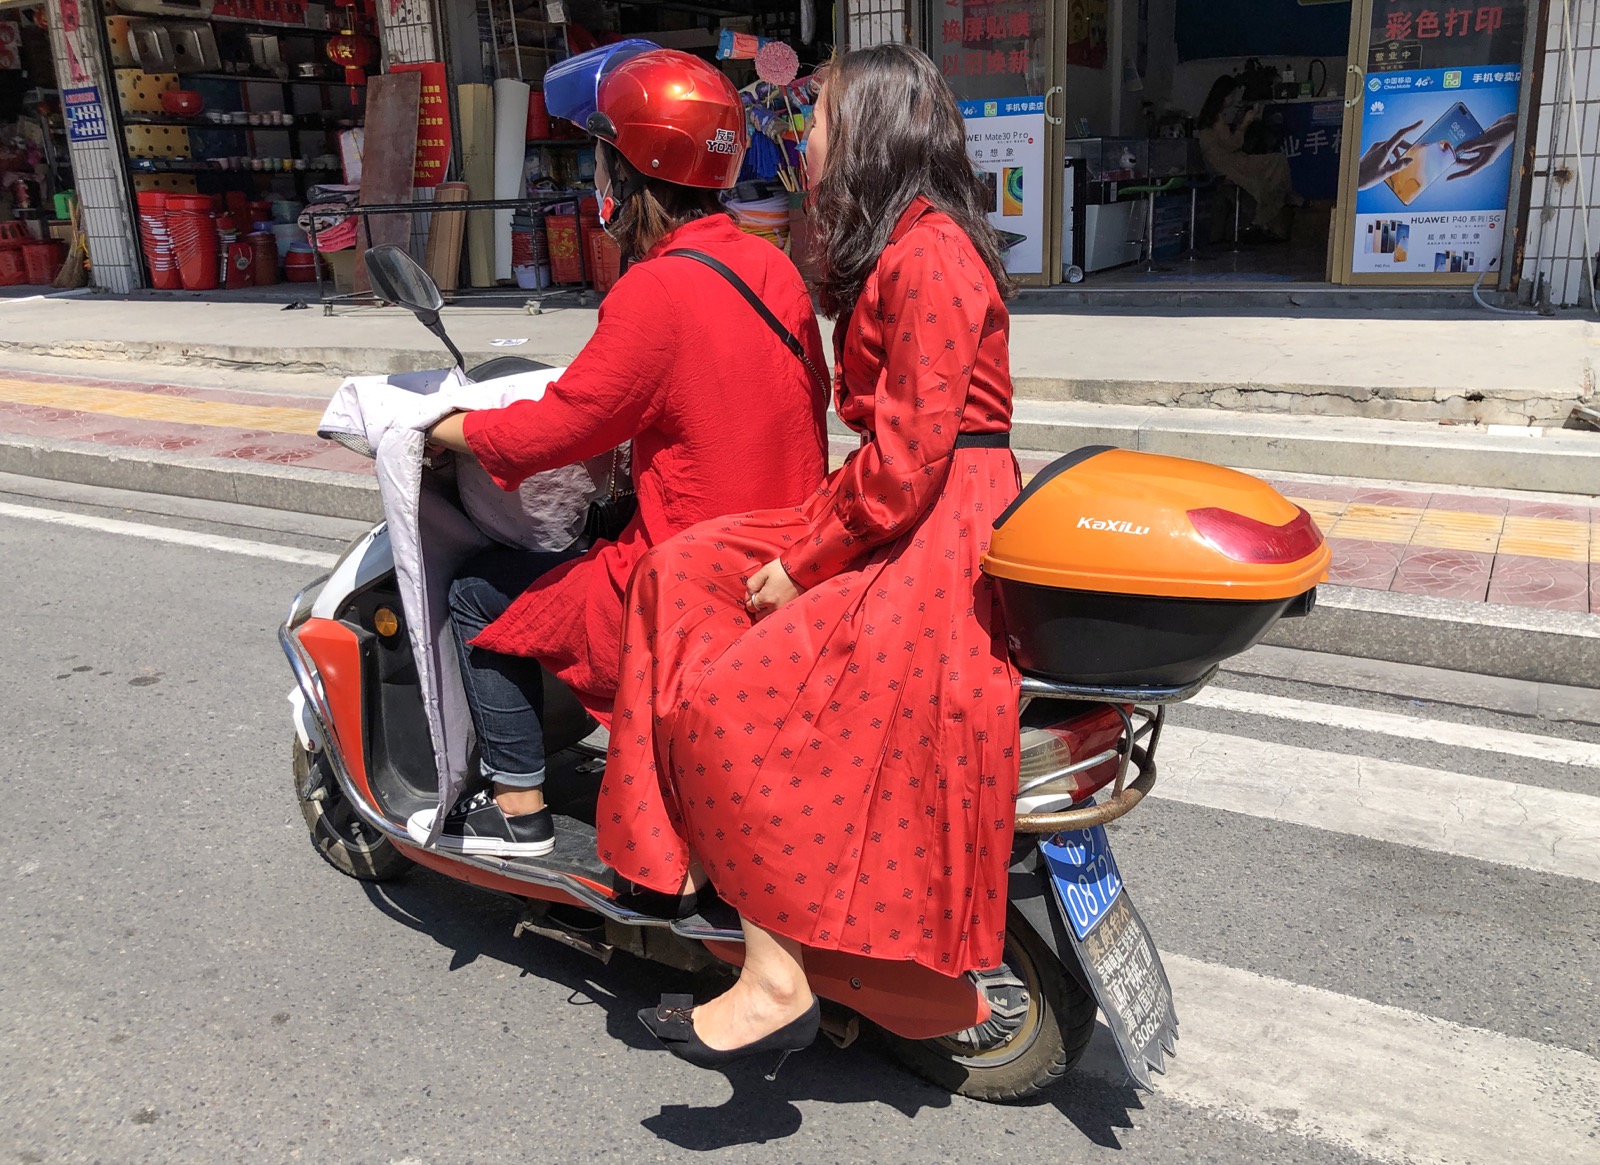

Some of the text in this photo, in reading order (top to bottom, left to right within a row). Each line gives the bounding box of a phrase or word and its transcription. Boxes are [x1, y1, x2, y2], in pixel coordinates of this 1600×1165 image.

[942, 12, 1030, 44] 换屏贴膜
[1385, 7, 1503, 40] 彩色打印
[1375, 50, 1412, 62] 营业中
[942, 49, 1030, 77] 以旧换新
[1384, 76, 1412, 84] 中国移动
[1415, 77, 1428, 87] 4G
[1005, 101, 1044, 112] 手机专卖店
[985, 132, 1011, 141] Mate30
[1013, 131, 1029, 139] Pro
[1410, 216, 1449, 224] HUAWEI
[1452, 215, 1468, 223] P40
[1488, 214, 1501, 222] 5G
